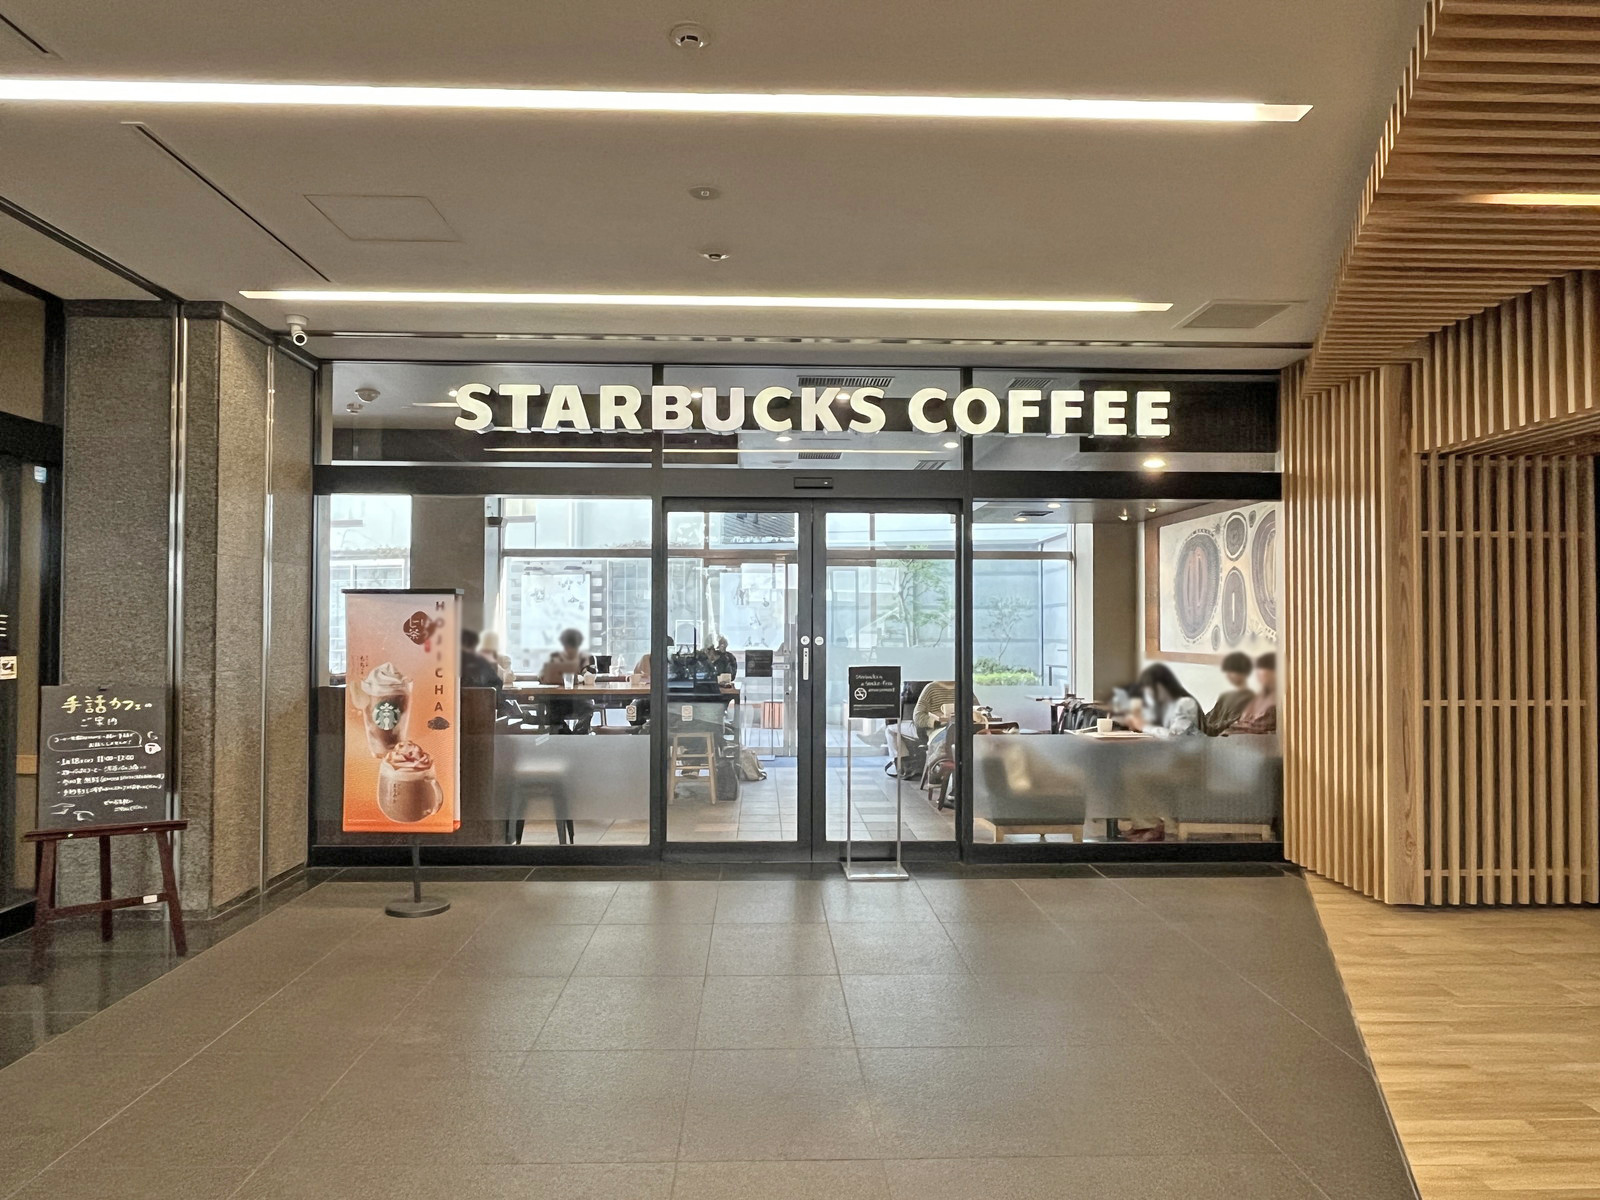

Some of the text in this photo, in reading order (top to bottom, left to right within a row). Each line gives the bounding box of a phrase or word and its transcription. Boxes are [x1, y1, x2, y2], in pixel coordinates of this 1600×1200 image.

[454, 383, 1171, 436] STARBUCKS COFFEE
[61, 695, 153, 714] 手話カフェの
